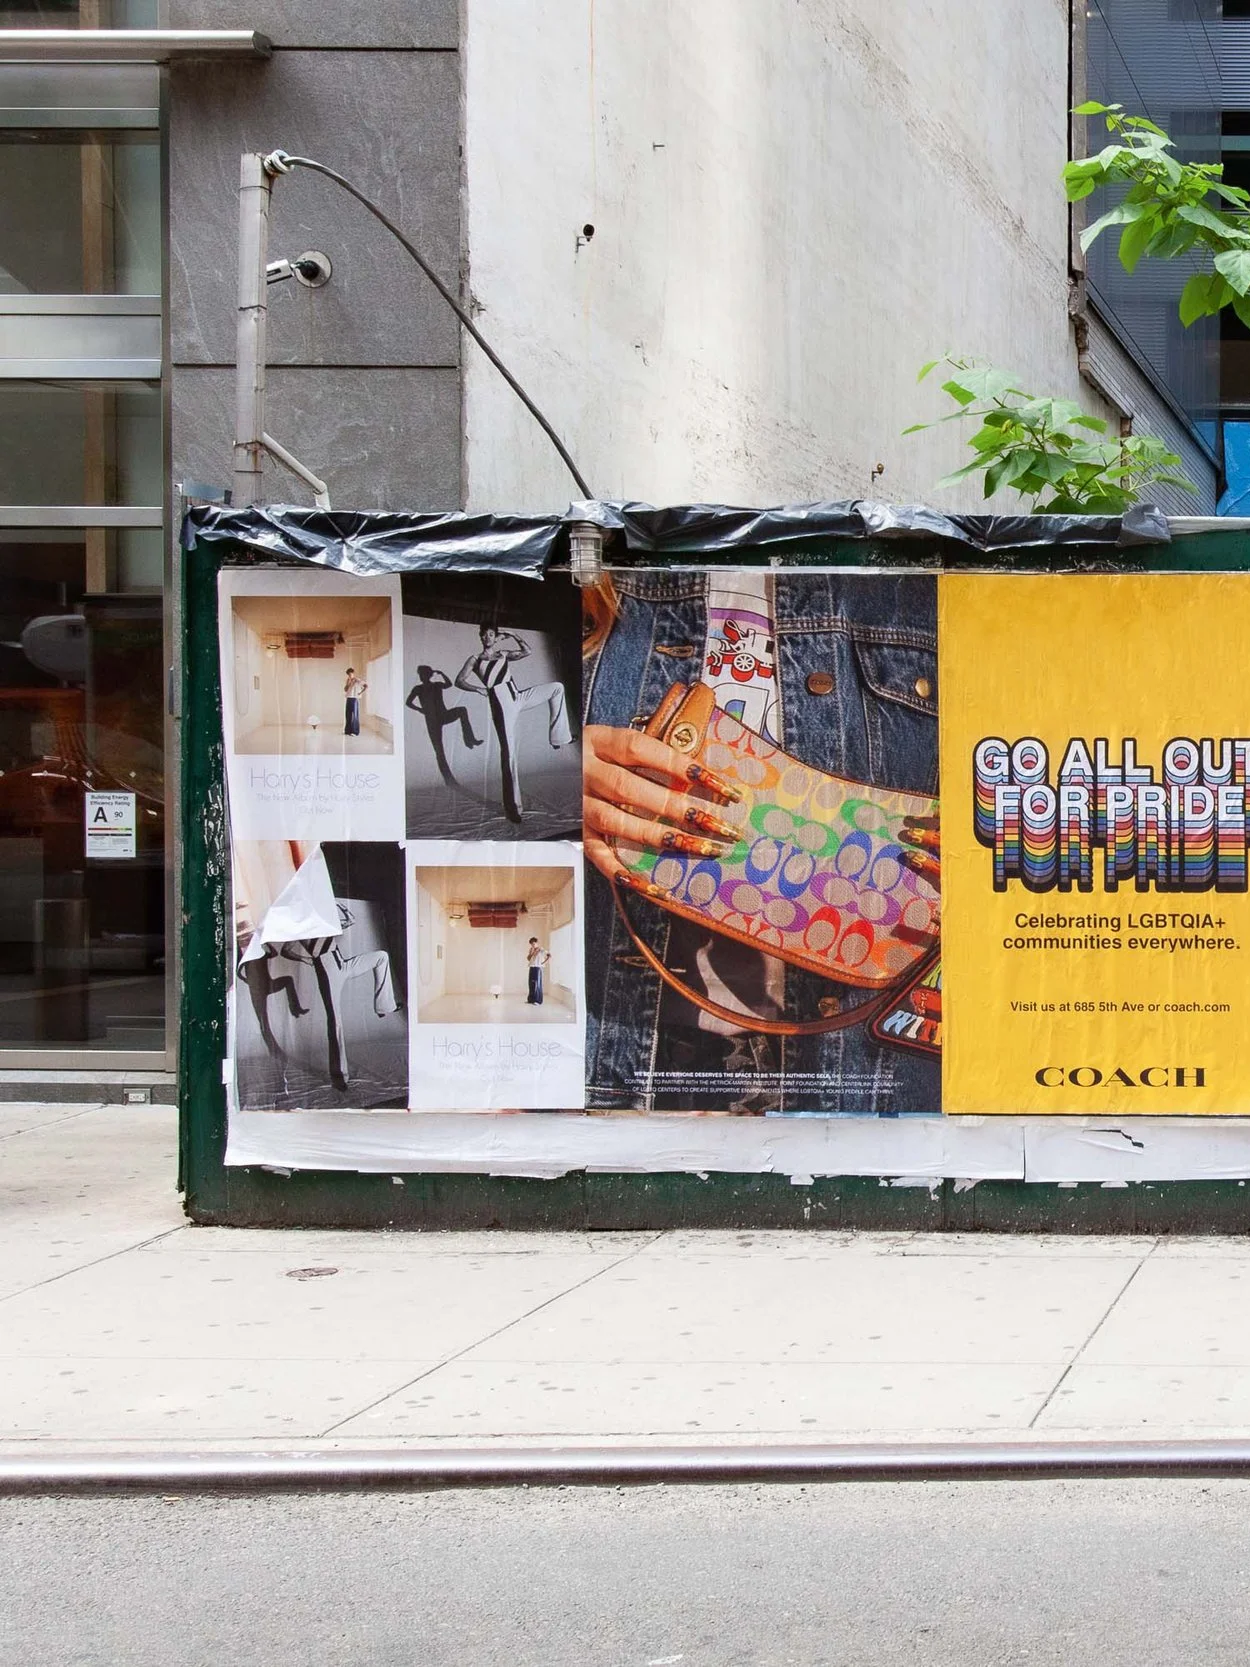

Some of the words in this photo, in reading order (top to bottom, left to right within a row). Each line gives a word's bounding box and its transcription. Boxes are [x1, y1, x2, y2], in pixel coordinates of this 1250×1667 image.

[974, 737, 1049, 779] GO
[1059, 737, 1153, 778] ALL
[250, 767, 312, 793] Harry's
[316, 767, 380, 789] House
[93, 806, 108, 823] A
[993, 784, 1093, 824] FOR
[1104, 785, 1248, 823] PRIDE
[1014, 912, 1122, 931] Celebrating
[1127, 913, 1227, 930] LGBTQIA+
[1002, 934, 1122, 951] communities
[1127, 935, 1241, 953] everywhere.
[1010, 1001, 1038, 1013] Visit
[1041, 1004, 1056, 1013] us
[1058, 1002, 1071, 1013] at
[1074, 1002, 1096, 1013] 685
[1098, 1001, 1118, 1013] 5th
[1121, 1002, 1145, 1013] Ave
[1148, 1004, 1161, 1013] or
[1163, 1001, 1231, 1013] coach.com
[432, 1035, 494, 1061] Harry's
[498, 1036, 563, 1057] House
[1035, 1066, 1208, 1088] COACH
